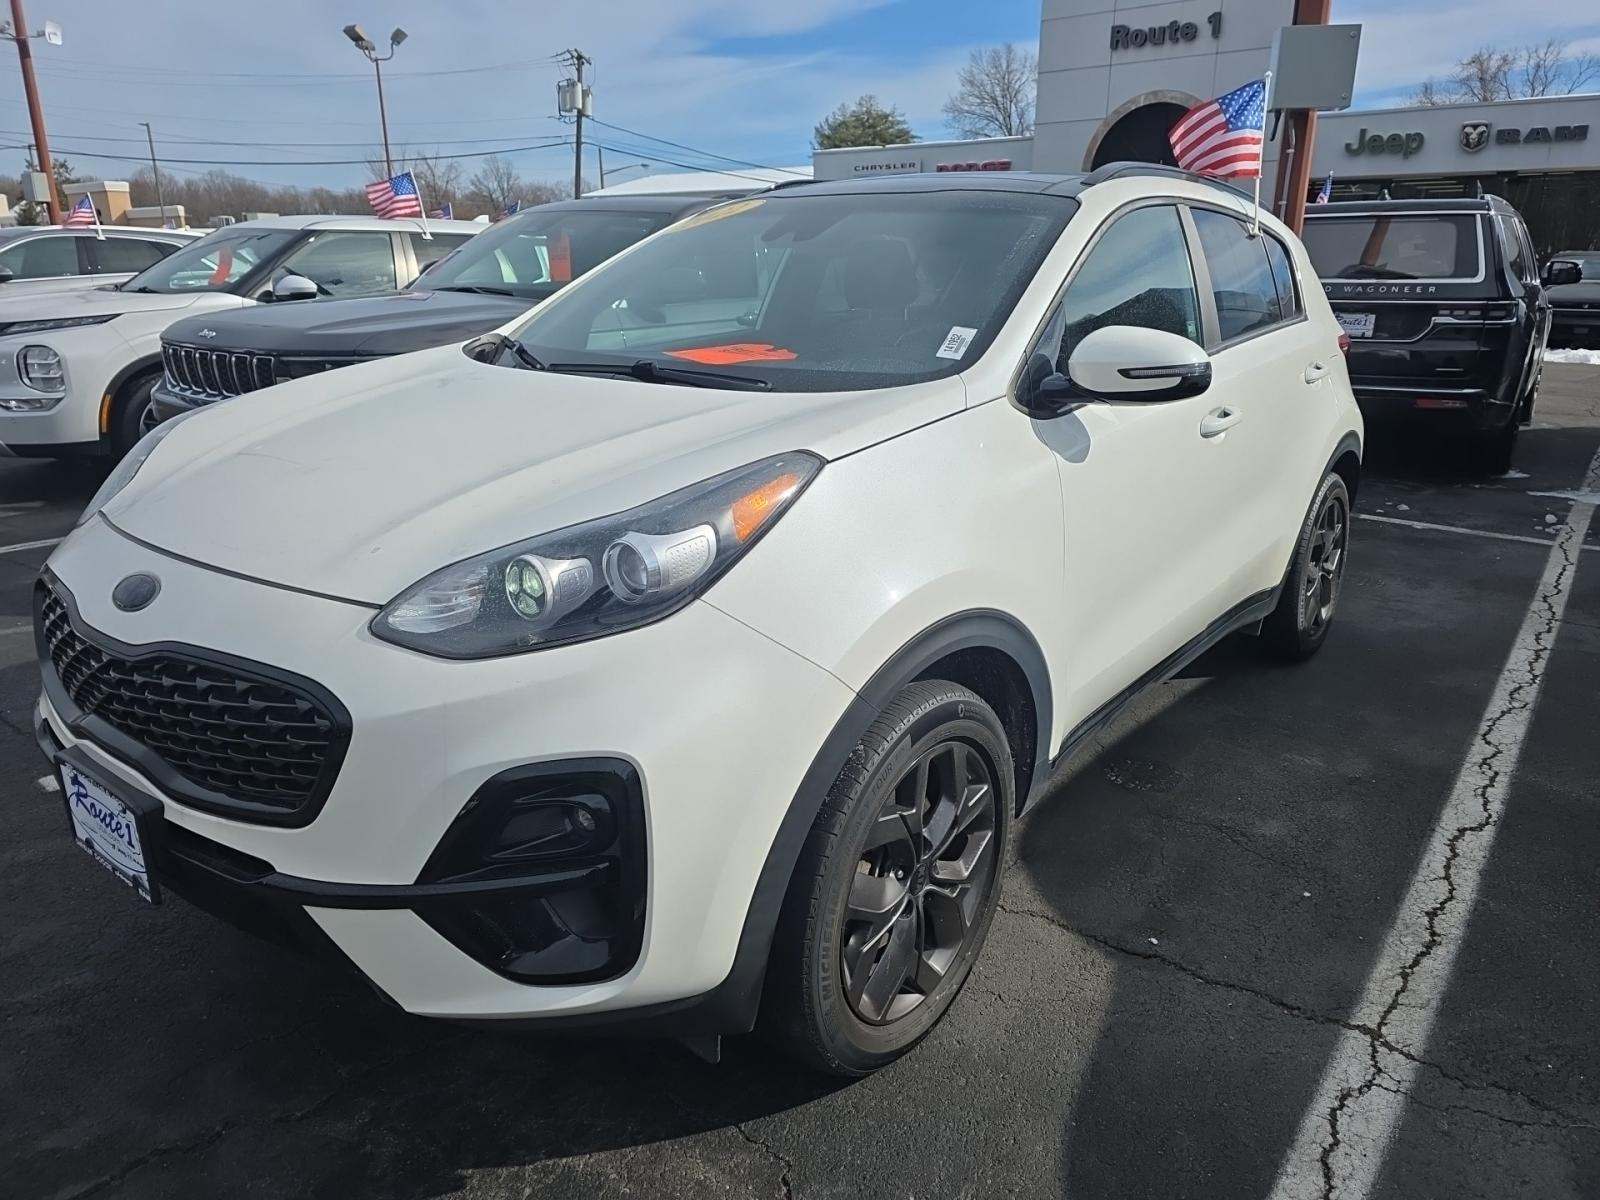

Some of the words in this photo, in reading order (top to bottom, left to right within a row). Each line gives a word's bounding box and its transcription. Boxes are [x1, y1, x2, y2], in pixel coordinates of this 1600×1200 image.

[1110, 20, 1198, 50] Route
[1207, 11, 1222, 39] 1
[1345, 128, 1425, 159] Jeep
[1495, 125, 1590, 145] RAM
[854, 162, 916, 172] CHRYSLER
[1344, 285, 1436, 293] WAGONEER
